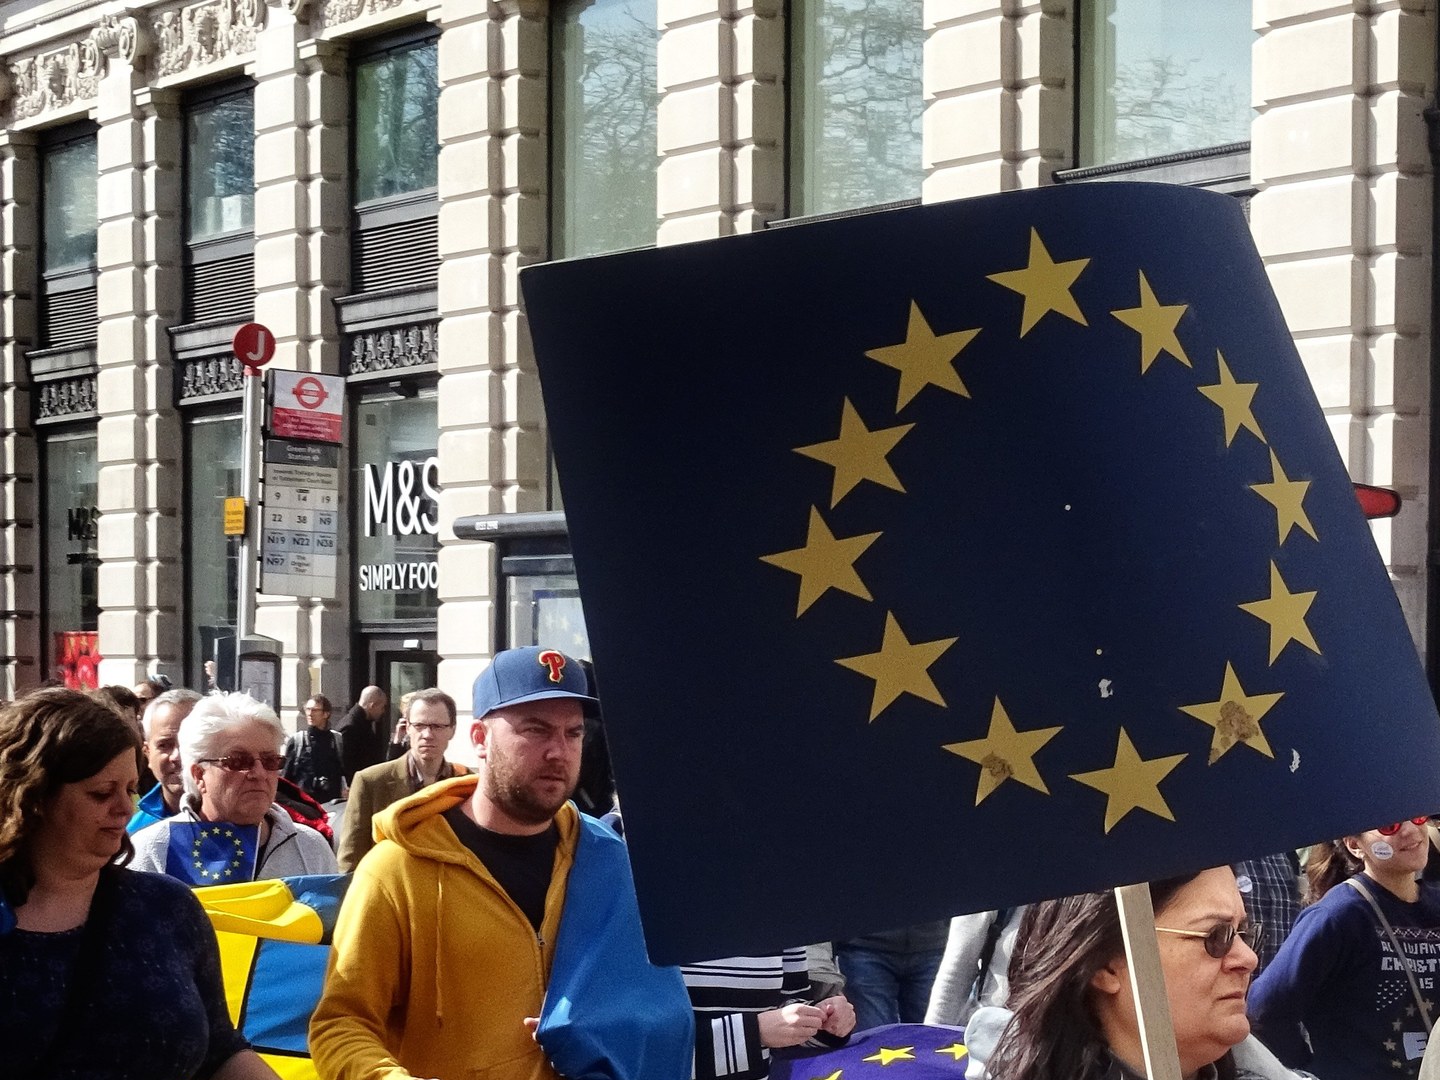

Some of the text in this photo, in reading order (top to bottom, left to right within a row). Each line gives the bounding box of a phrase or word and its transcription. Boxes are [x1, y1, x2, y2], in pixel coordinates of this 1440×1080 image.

[246, 330, 265, 361] J
[274, 491, 281, 500] 9
[297, 494, 308, 502] 14
[321, 495, 332, 503] 19
[365, 456, 440, 537] M&S
[272, 513, 283, 523] 22
[296, 515, 308, 524] 38
[320, 517, 332, 526] N9
[267, 535, 286, 544] N19
[292, 537, 310, 546] N22
[316, 539, 334, 548] N38
[266, 557, 285, 566] N97
[359, 561, 439, 592] SIMPLY FOO
[538, 650, 566, 683] P
[1419, 977, 1434, 989] IS
